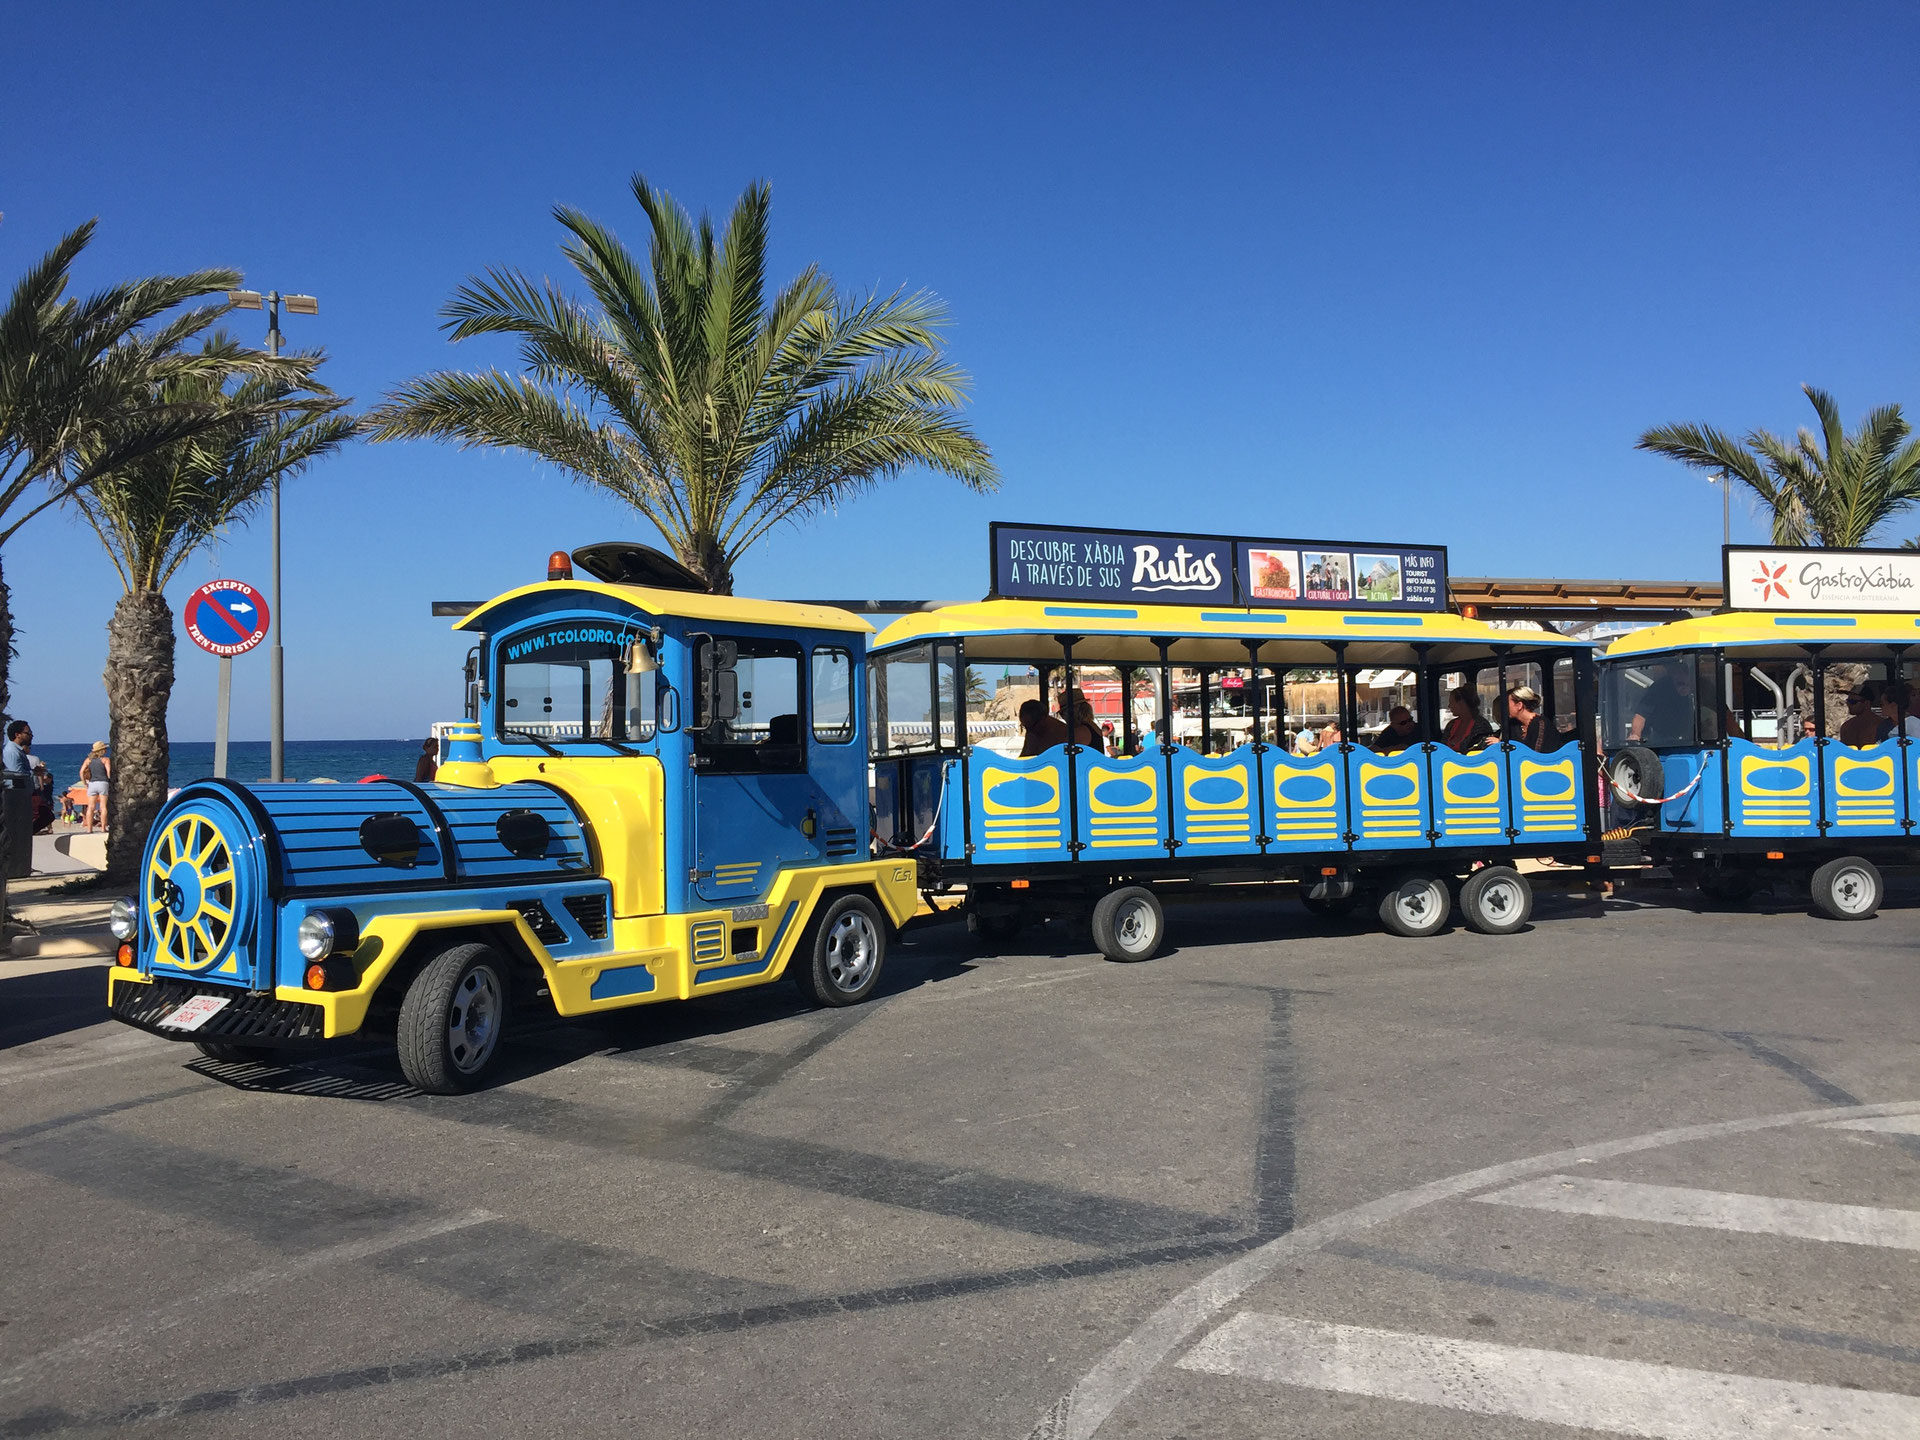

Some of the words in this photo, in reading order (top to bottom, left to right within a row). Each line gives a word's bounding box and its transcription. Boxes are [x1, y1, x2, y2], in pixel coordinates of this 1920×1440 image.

[1010, 540, 1076, 563] DESCUBRE
[1084, 540, 1125, 566] XÀBIA
[1405, 554, 1417, 567] MÁS
[1420, 557, 1434, 568] INFO
[1011, 562, 1020, 583] A
[1026, 562, 1074, 587] TRAVÉS
[1077, 566, 1092, 588] DE
[1099, 567, 1121, 588] SUS
[1131, 544, 1222, 592] Rutas
[201, 581, 251, 594] EXCEPTO
[188, 623, 211, 648] TREN
[210, 630, 263, 654] TURISTICO
[508, 629, 646, 660] WWW.TCOLODRO.CO
